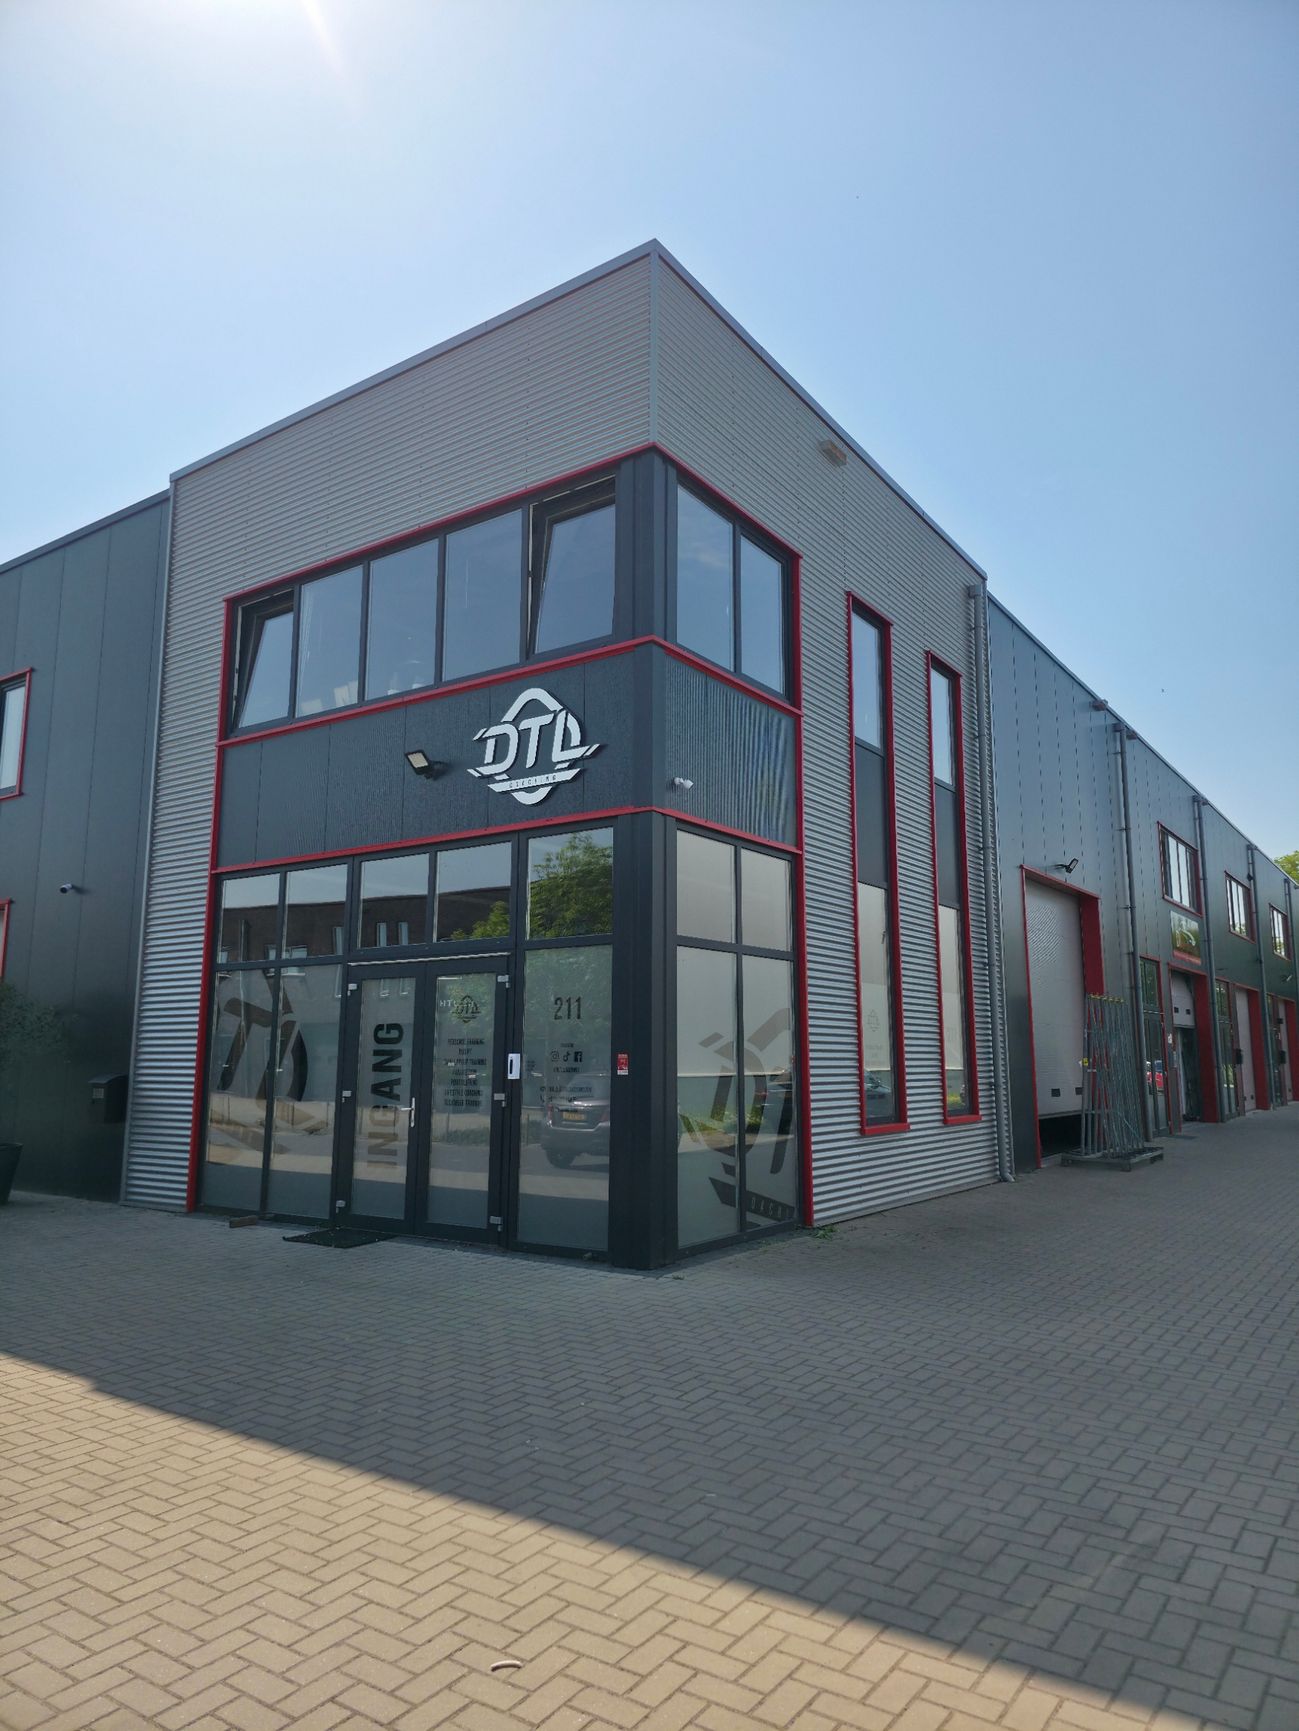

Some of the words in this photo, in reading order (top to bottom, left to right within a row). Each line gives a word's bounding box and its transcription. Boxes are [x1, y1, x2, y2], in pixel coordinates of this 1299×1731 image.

[469, 710, 600, 778] DTL
[554, 996, 582, 1020] 211
[367, 1022, 404, 1169] INGANG
